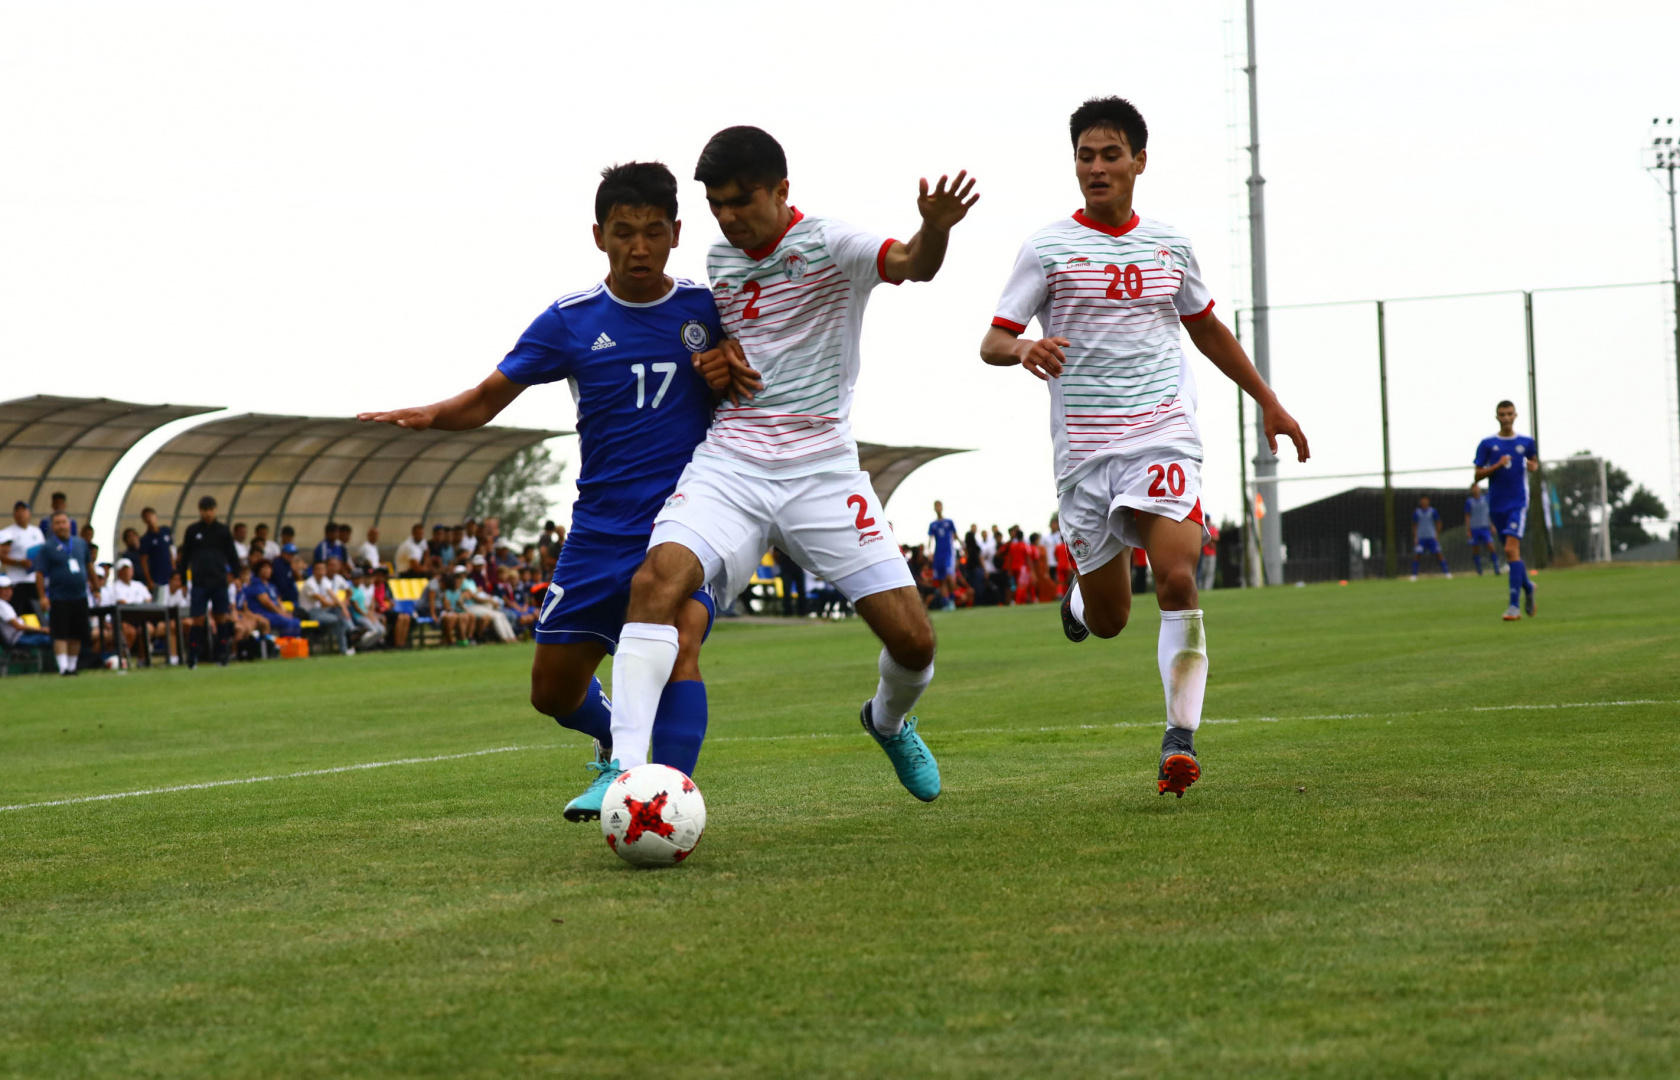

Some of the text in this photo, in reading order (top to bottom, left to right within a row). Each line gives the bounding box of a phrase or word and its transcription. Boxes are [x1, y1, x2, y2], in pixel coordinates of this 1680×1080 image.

[742, 280, 761, 319] 2
[1104, 264, 1143, 300] 20
[591, 341, 617, 351] adidas
[631, 362, 677, 409] 17
[1147, 463, 1185, 497] 20
[847, 494, 876, 530] 2
[539, 582, 565, 624] 7
